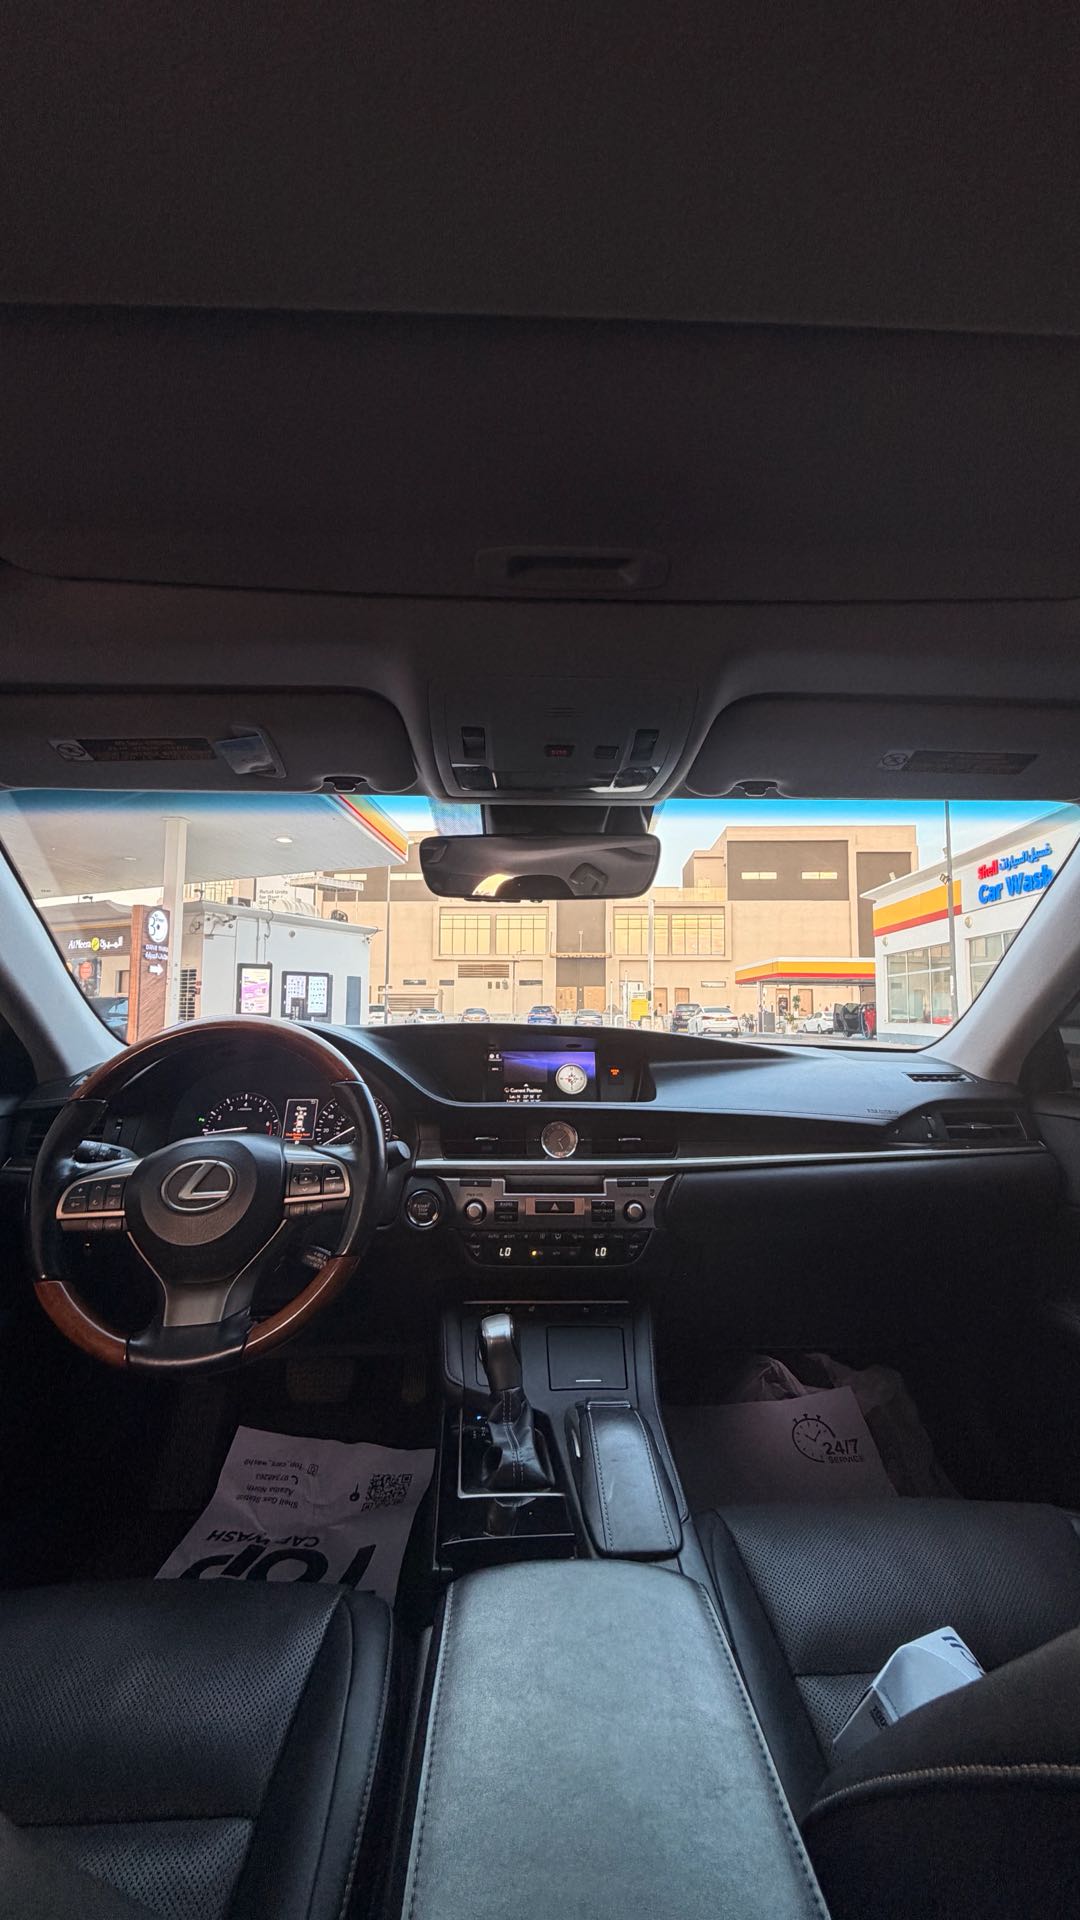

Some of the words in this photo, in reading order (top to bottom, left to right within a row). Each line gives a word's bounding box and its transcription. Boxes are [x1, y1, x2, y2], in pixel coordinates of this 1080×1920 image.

[999, 850, 1029, 871] السيارات
[1027, 843, 1053, 863] غسيل
[977, 859, 999, 880] Shell
[978, 882, 1004, 905] Car
[1005, 864, 1054, 897] Wash
[823, 1438, 858, 1455] 24/7
[279, 1497, 299, 1509] Shell
